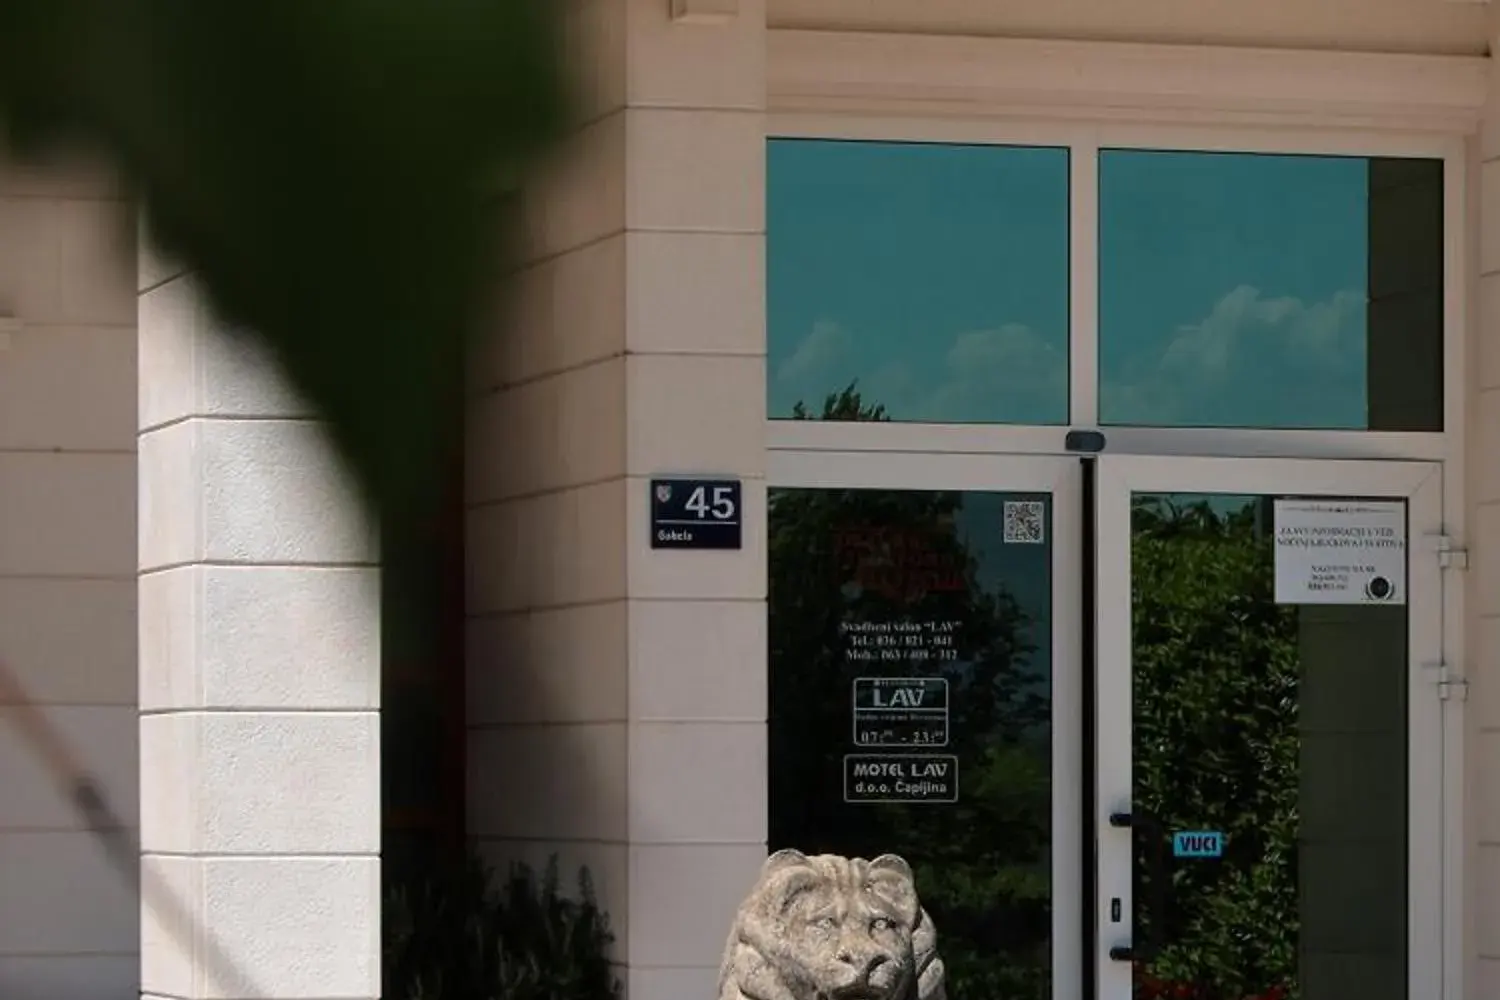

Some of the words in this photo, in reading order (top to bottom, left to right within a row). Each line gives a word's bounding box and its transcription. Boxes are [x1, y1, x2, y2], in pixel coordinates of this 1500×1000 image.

[685, 486, 735, 519] 45
[873, 688, 925, 707] LAV
[853, 763, 905, 778] MOTEL
[911, 763, 949, 778] LAV
[855, 781, 891, 793] d.o.o.
[1180, 836, 1217, 852] VUCI
